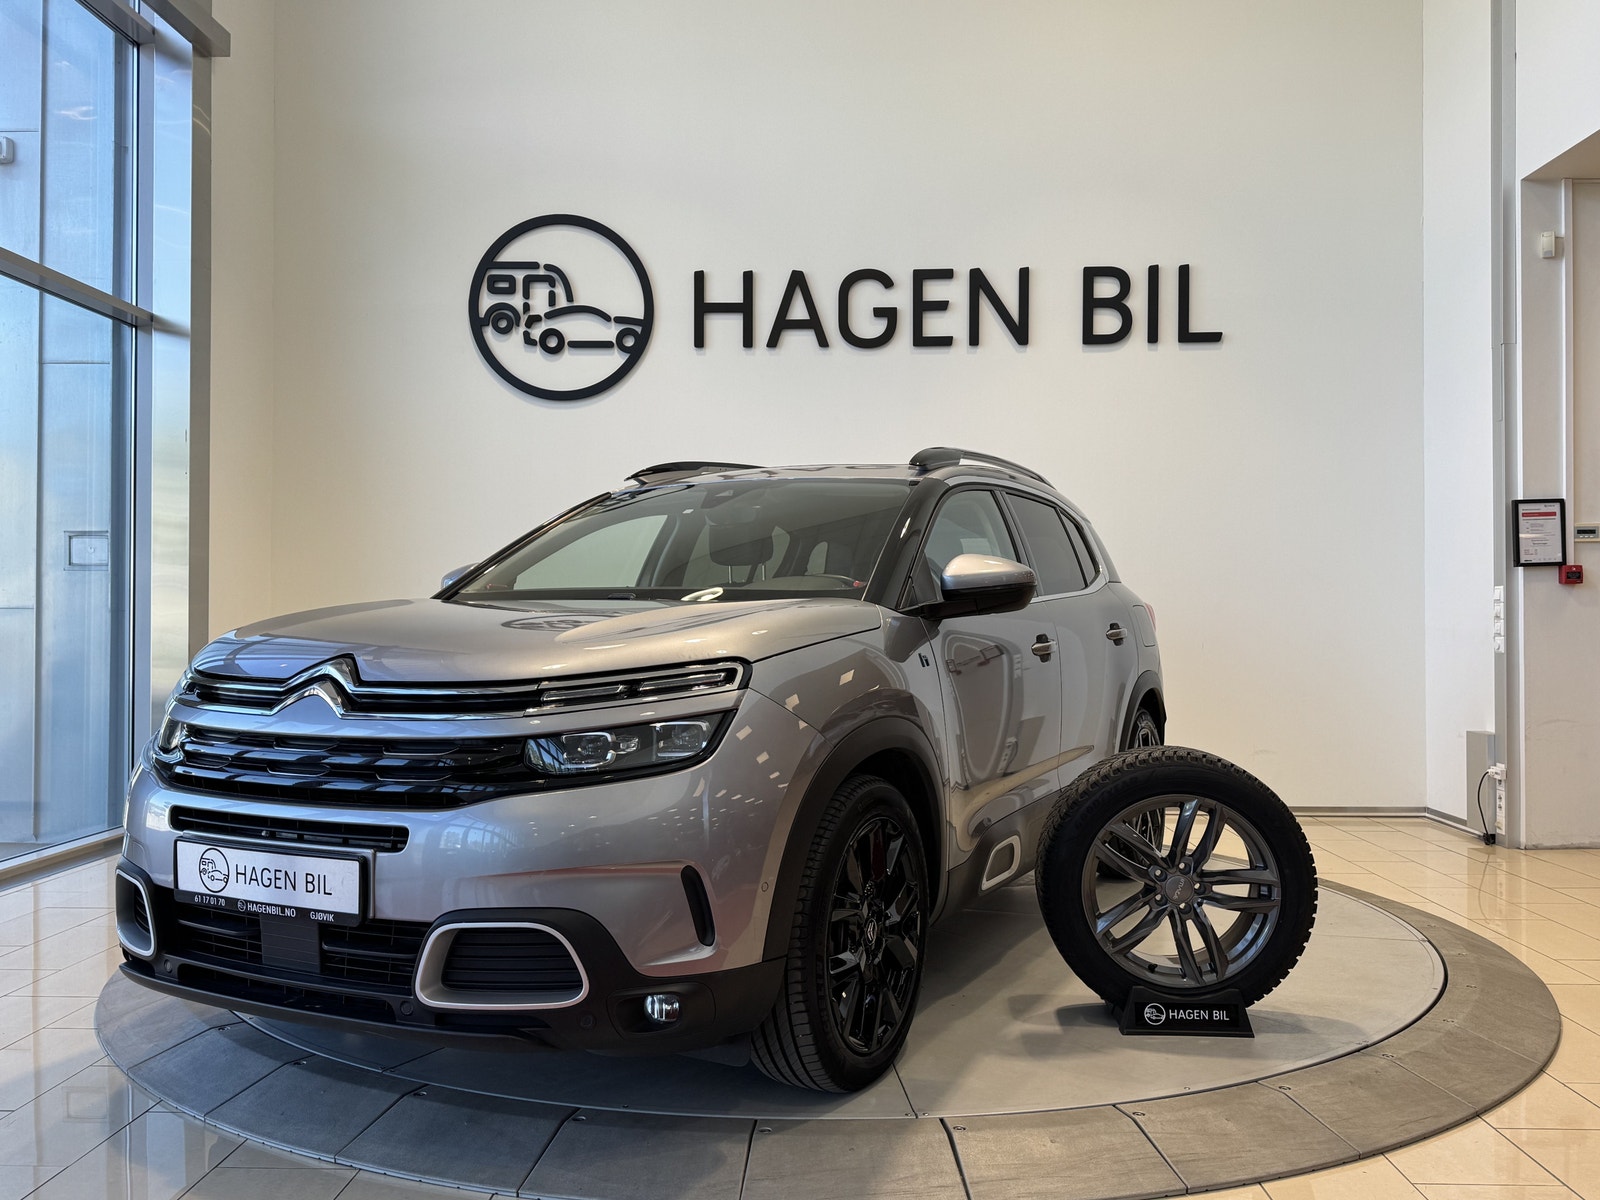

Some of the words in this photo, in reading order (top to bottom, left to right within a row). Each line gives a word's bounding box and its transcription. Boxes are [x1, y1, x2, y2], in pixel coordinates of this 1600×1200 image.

[693, 266, 1030, 349] HAGEN
[1082, 263, 1223, 345] BIL
[235, 863, 297, 892] HAGEN
[305, 872, 333, 896] BIL
[194, 894, 201, 903] 61
[203, 895, 210, 904] 17
[210, 896, 217, 905] 01
[218, 897, 226, 907] 70
[247, 902, 296, 917] HAGENBIL.NO
[309, 911, 335, 922] GJØVIK
[1169, 1009, 1209, 1020] HAGEN
[1212, 1010, 1230, 1021] BIL
